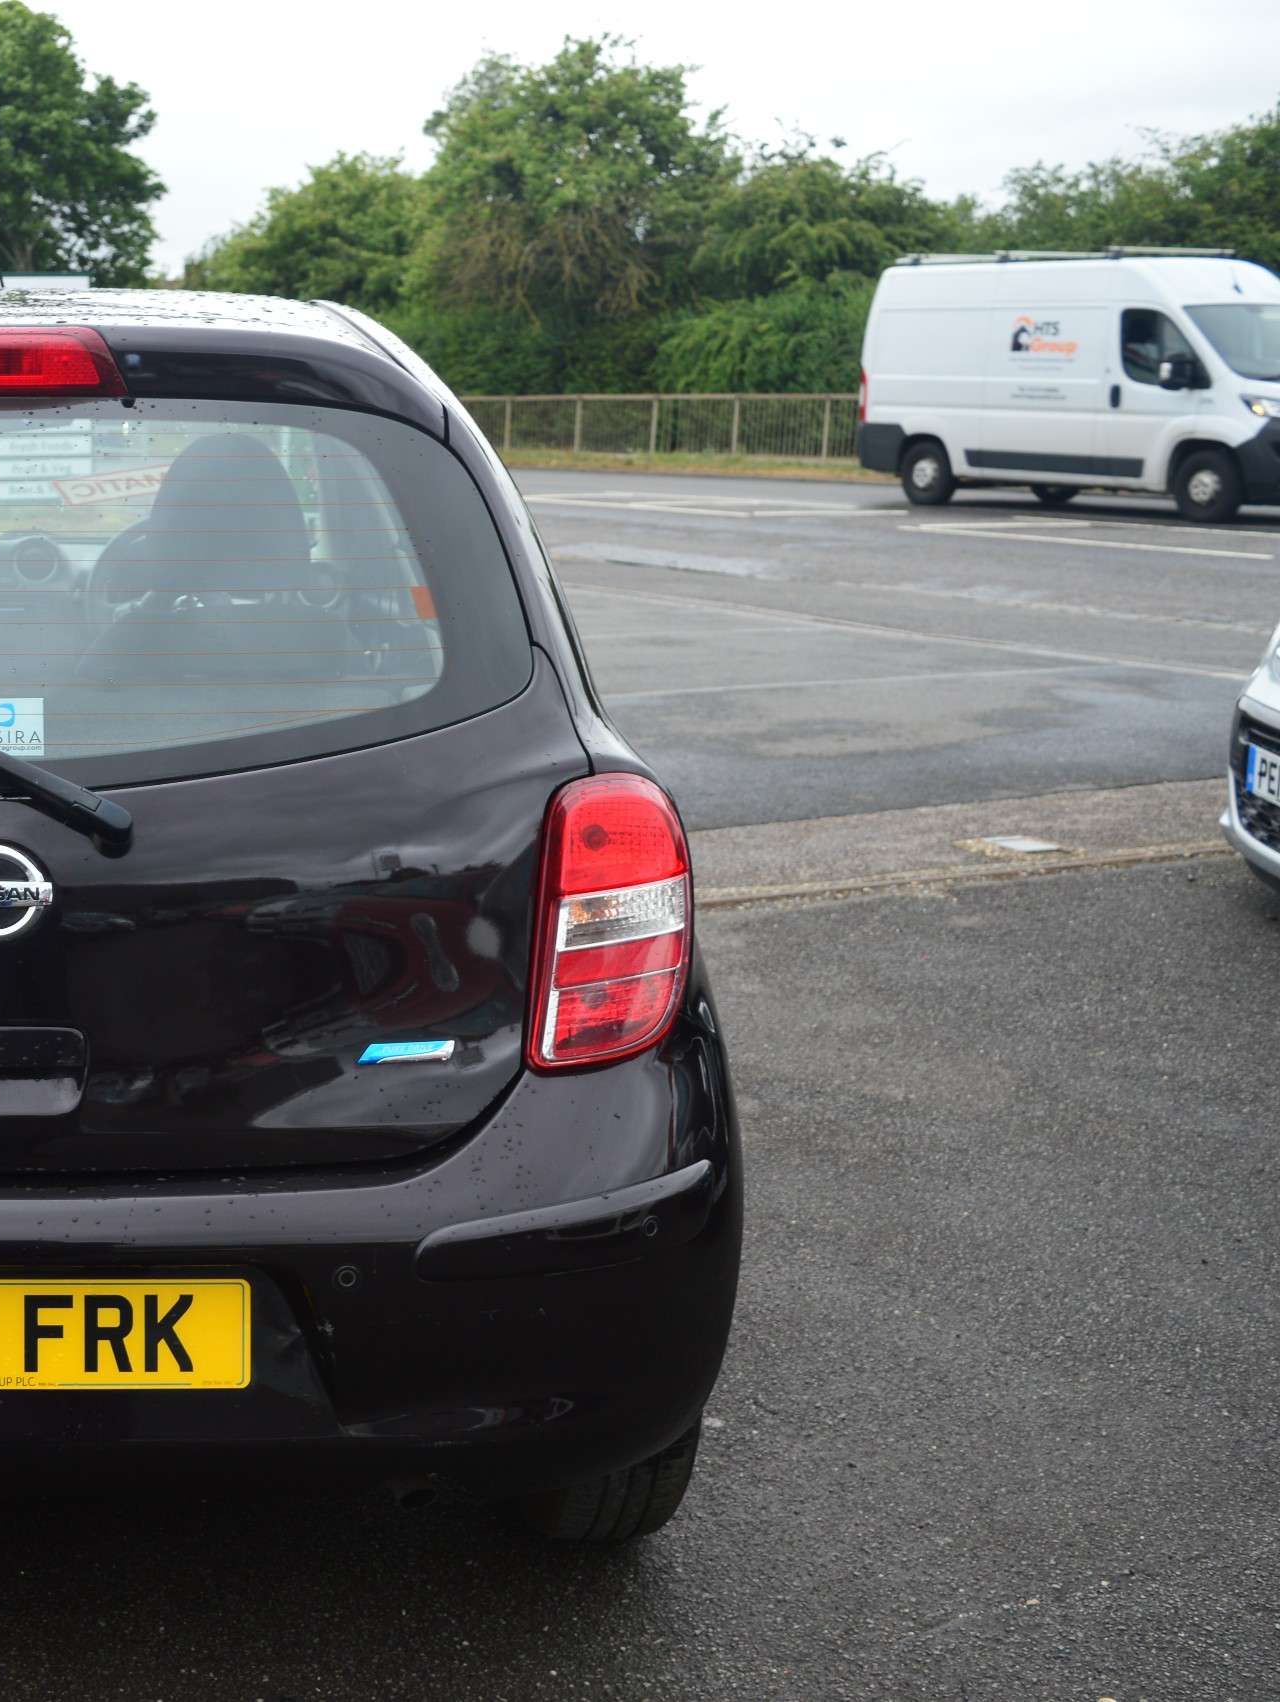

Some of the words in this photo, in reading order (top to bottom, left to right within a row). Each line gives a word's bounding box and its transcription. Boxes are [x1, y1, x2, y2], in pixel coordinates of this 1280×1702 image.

[1033, 321, 1060, 336] HTS
[1030, 340, 1078, 356] Group
[1257, 758, 1280, 797] PE
[23, 1293, 195, 1373] FRK
[15, 1376, 36, 1387] PLC
